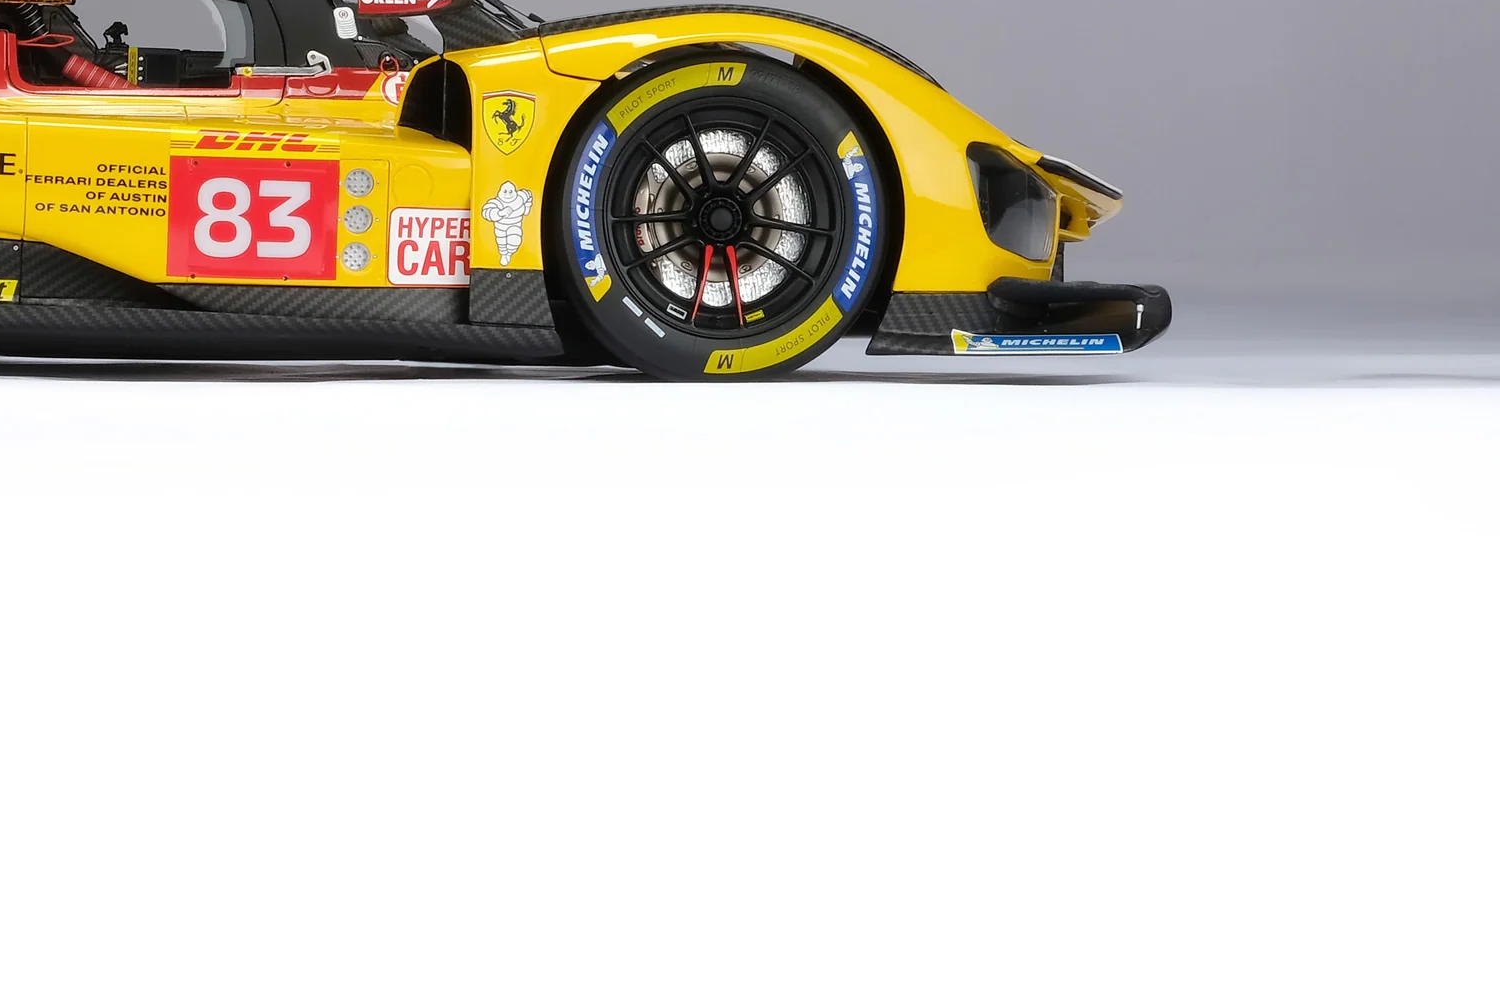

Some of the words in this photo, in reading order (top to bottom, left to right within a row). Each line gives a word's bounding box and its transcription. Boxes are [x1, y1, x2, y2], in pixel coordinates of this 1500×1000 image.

[717, 67, 734, 82] M
[619, 95, 644, 119] PILOT
[646, 77, 676, 98] SPORT
[195, 129, 318, 152] DHL
[97, 164, 167, 176] OFFICIAL
[25, 174, 92, 186] FERRARI
[96, 178, 168, 190] DEALERS
[575, 134, 609, 251] MICHELIN
[86, 190, 106, 201] OF
[109, 191, 167, 203] AUSTIN
[35, 202, 55, 213] OF
[60, 203, 92, 214] SAN
[94, 205, 166, 217] ANTONIO
[194, 177, 312, 258] 83
[398, 216, 470, 238] HYPER
[841, 182, 873, 299] MICHELIN
[397, 239, 470, 276] CAR
[807, 313, 831, 338] PILOT
[775, 334, 805, 356] SPORT
[1001, 338, 1104, 346] MICHELIN
[716, 354, 734, 370] M
